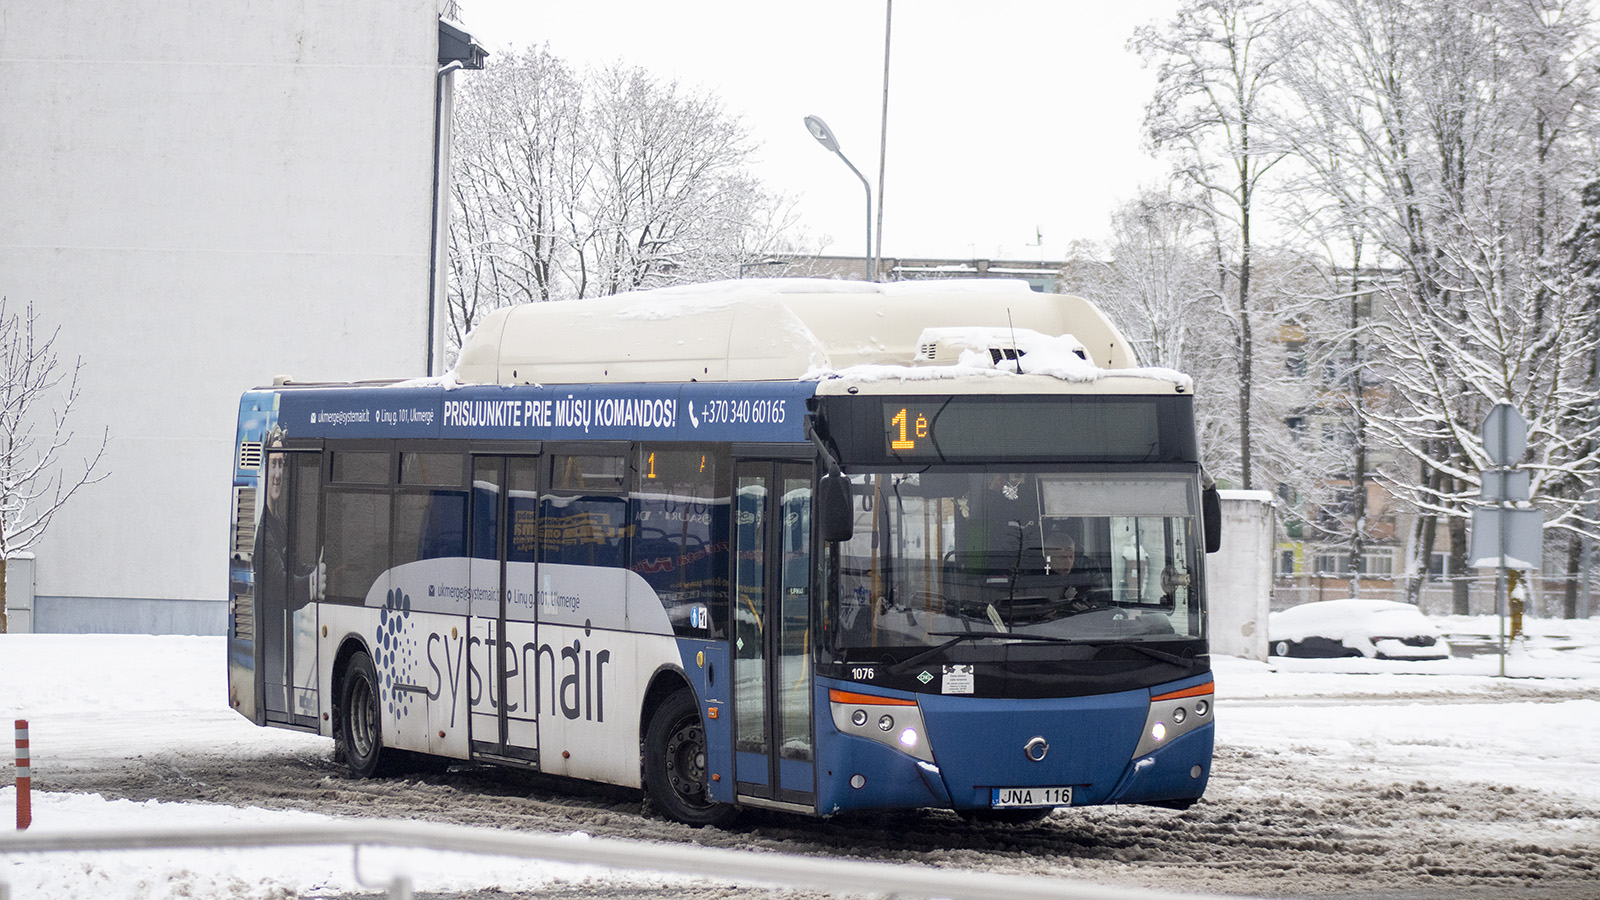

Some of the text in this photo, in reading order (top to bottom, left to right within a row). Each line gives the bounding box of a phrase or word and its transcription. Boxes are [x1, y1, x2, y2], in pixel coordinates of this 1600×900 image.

[317, 409, 370, 426] ukmerge@systemair.lt
[393, 412, 398, 426] g.
[399, 409, 410, 424] 101,
[411, 408, 434, 426] Ukmergė
[443, 395, 677, 433] PRISIJUNKITE PRIE MŪSŲ KOMANDOS!
[701, 400, 786, 424] +370 340 60165
[891, 408, 927, 449] 1 ė
[648, 452, 656, 478] 1
[437, 584, 500, 603] ukmerge@systemair.t
[551, 591, 580, 612] Ukmergė
[427, 618, 610, 728] systemair
[852, 668, 874, 680] 1076
[1001, 789, 1070, 804] JNA 116
